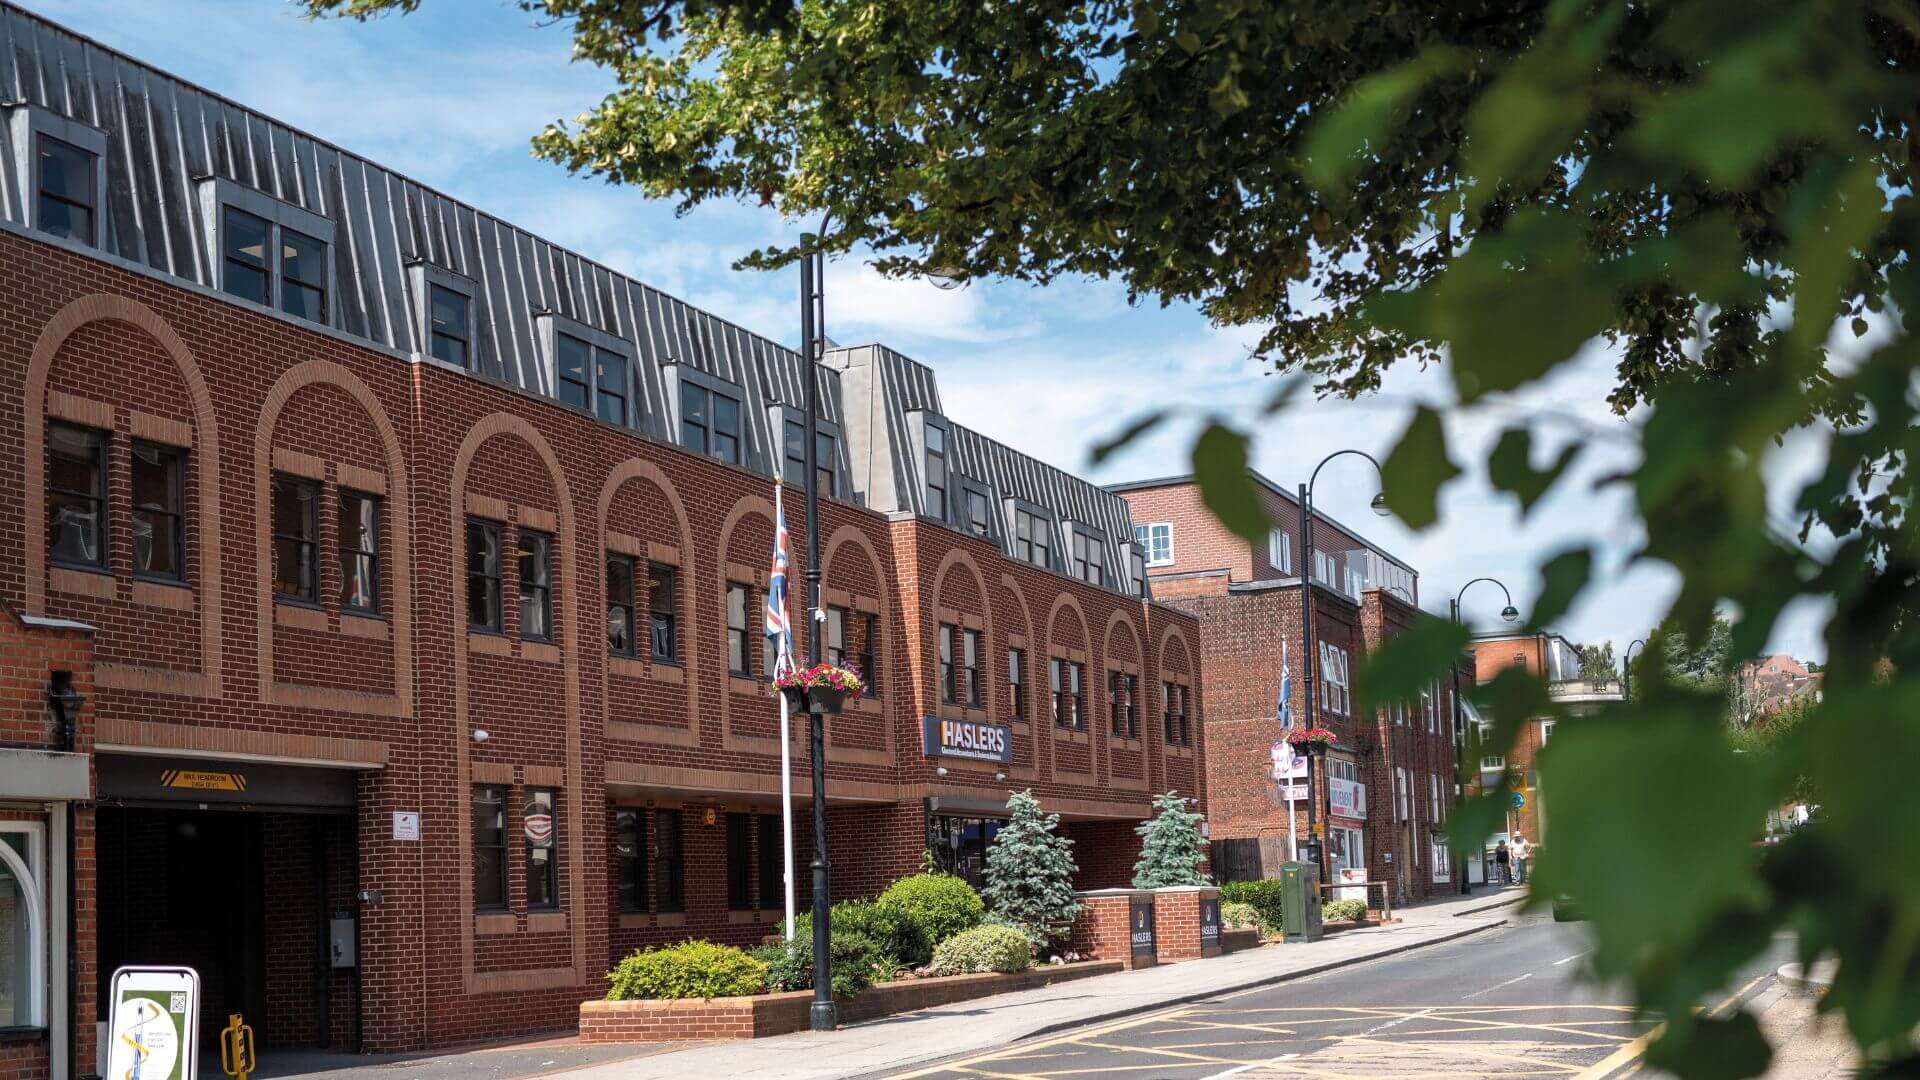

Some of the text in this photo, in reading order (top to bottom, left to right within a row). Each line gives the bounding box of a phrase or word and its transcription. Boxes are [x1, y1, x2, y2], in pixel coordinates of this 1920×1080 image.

[942, 720, 1004, 752] HASLERS
[1201, 924, 1218, 935] HASLERS
[1132, 931, 1151, 943] HASLERS
